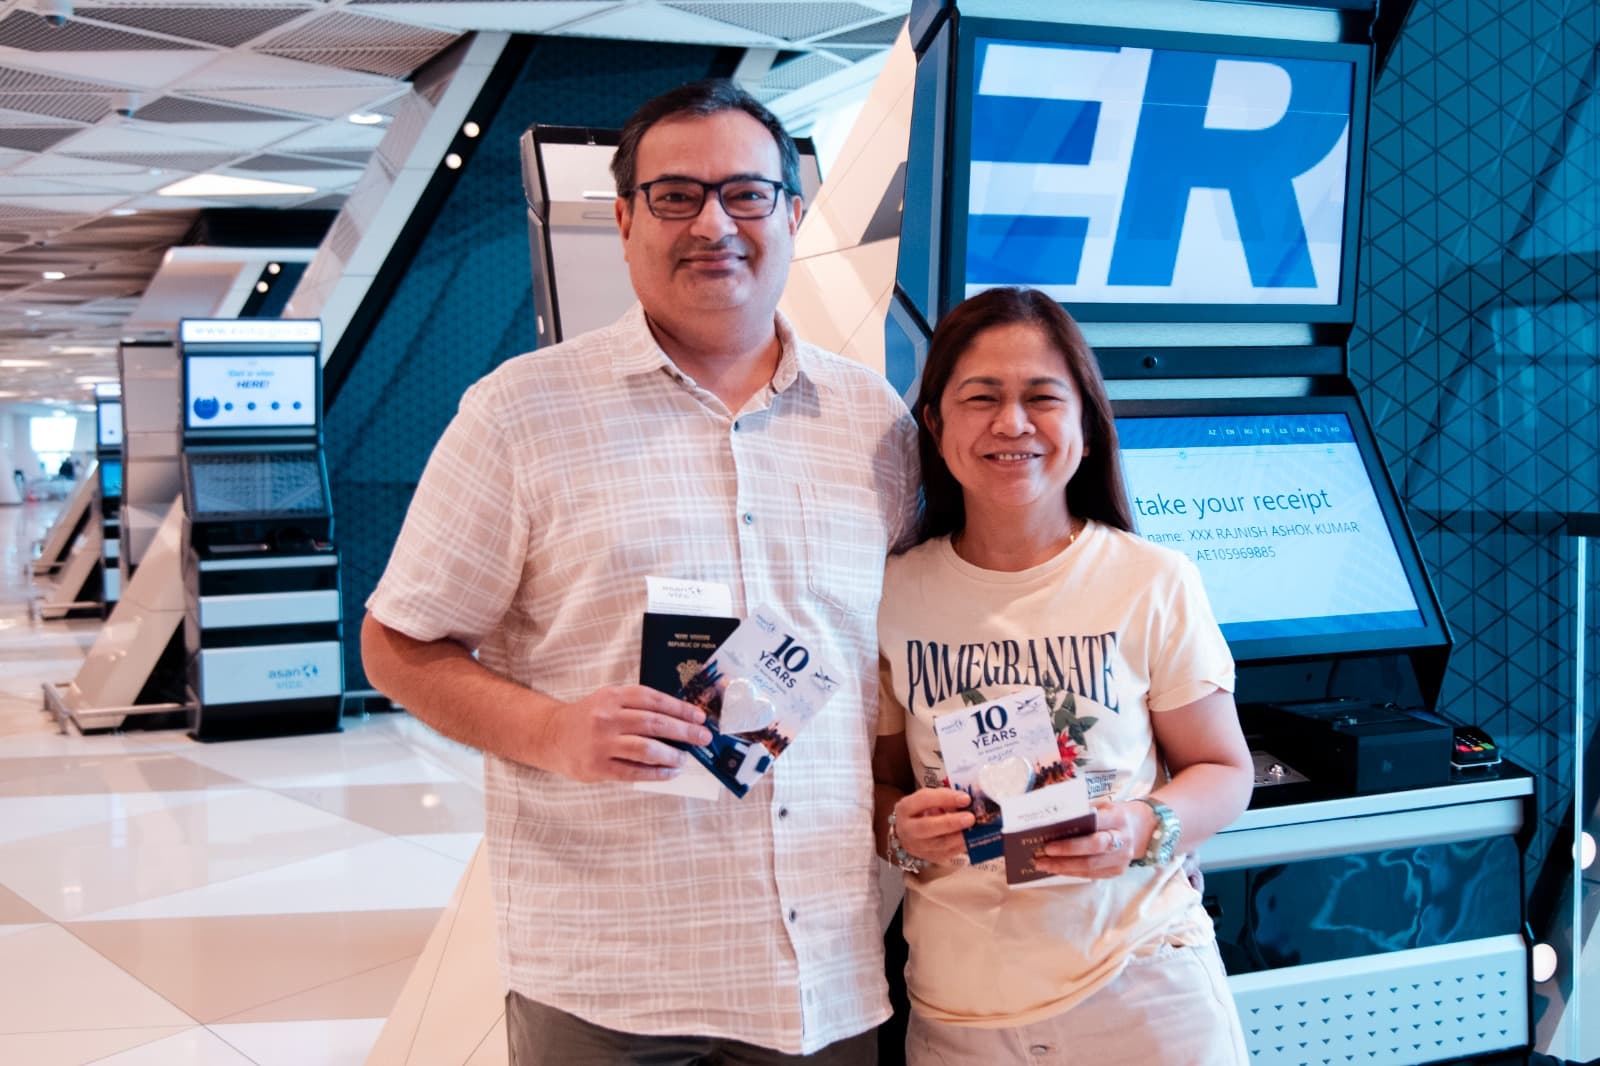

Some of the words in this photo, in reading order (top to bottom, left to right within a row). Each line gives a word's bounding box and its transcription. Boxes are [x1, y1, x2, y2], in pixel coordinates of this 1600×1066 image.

[1134, 493, 1187, 516] take
[1192, 495, 1245, 520] your
[1253, 488, 1333, 515] receipt
[1188, 528, 1214, 540] XXX
[1215, 526, 1269, 540] RAJNISH
[1271, 524, 1314, 537] ASHOK
[1315, 521, 1361, 535] KUMAR
[759, 649, 797, 689] YEARS
[769, 633, 810, 673] 10
[906, 631, 1120, 715] POMEGRANATE
[970, 705, 1009, 738] 10
[972, 727, 1018, 749] YEARS
